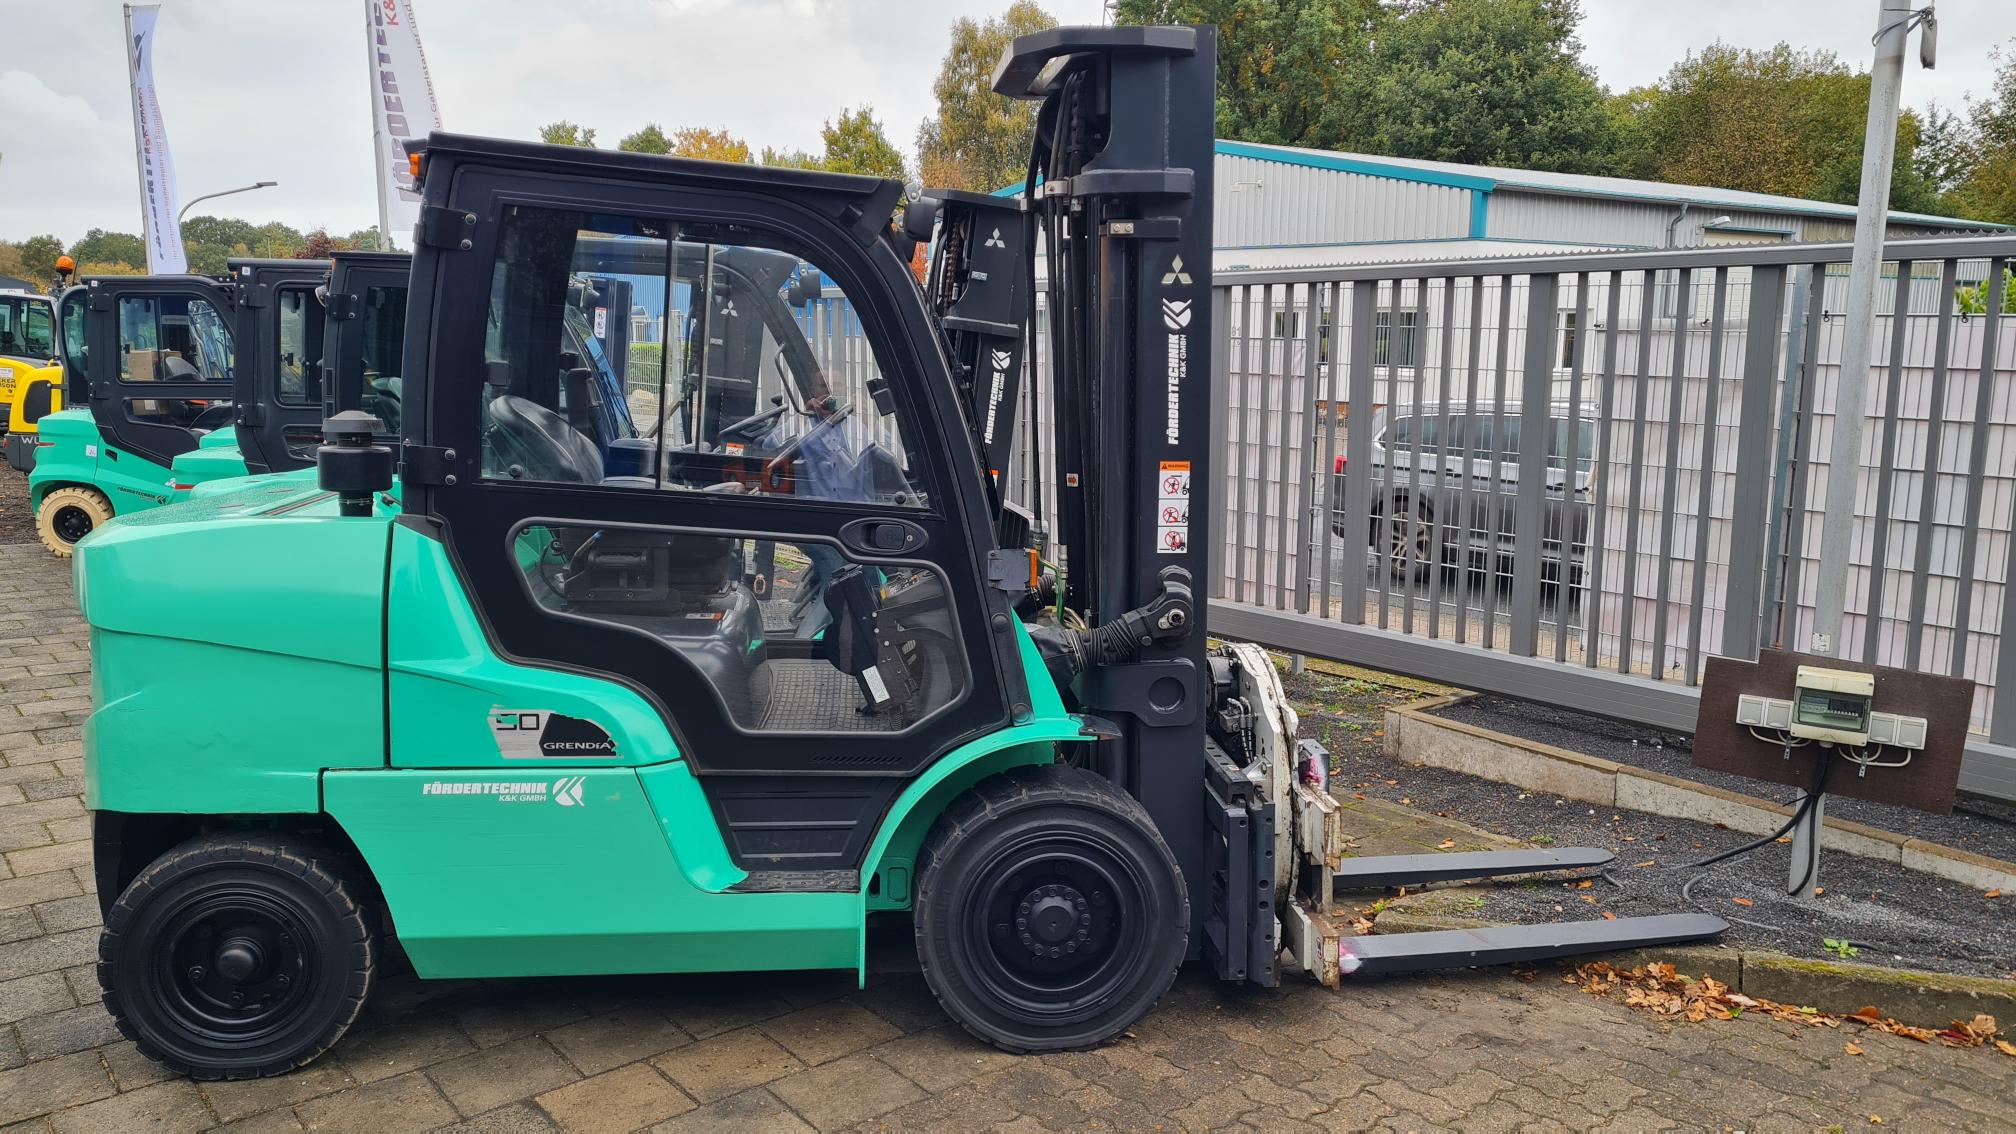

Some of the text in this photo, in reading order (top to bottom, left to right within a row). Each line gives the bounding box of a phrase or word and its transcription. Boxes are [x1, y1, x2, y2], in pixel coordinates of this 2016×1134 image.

[413, 33, 437, 112] Gabelstapler
[1179, 334, 1187, 378] K&K GMBH
[984, 371, 1001, 445] FÖRDERTECHNIK
[1166, 333, 1180, 445] FÖRDERTECHNIK
[422, 781, 548, 794] FÖRDERTECHNIK
[498, 794, 547, 802] K&K GMBH
